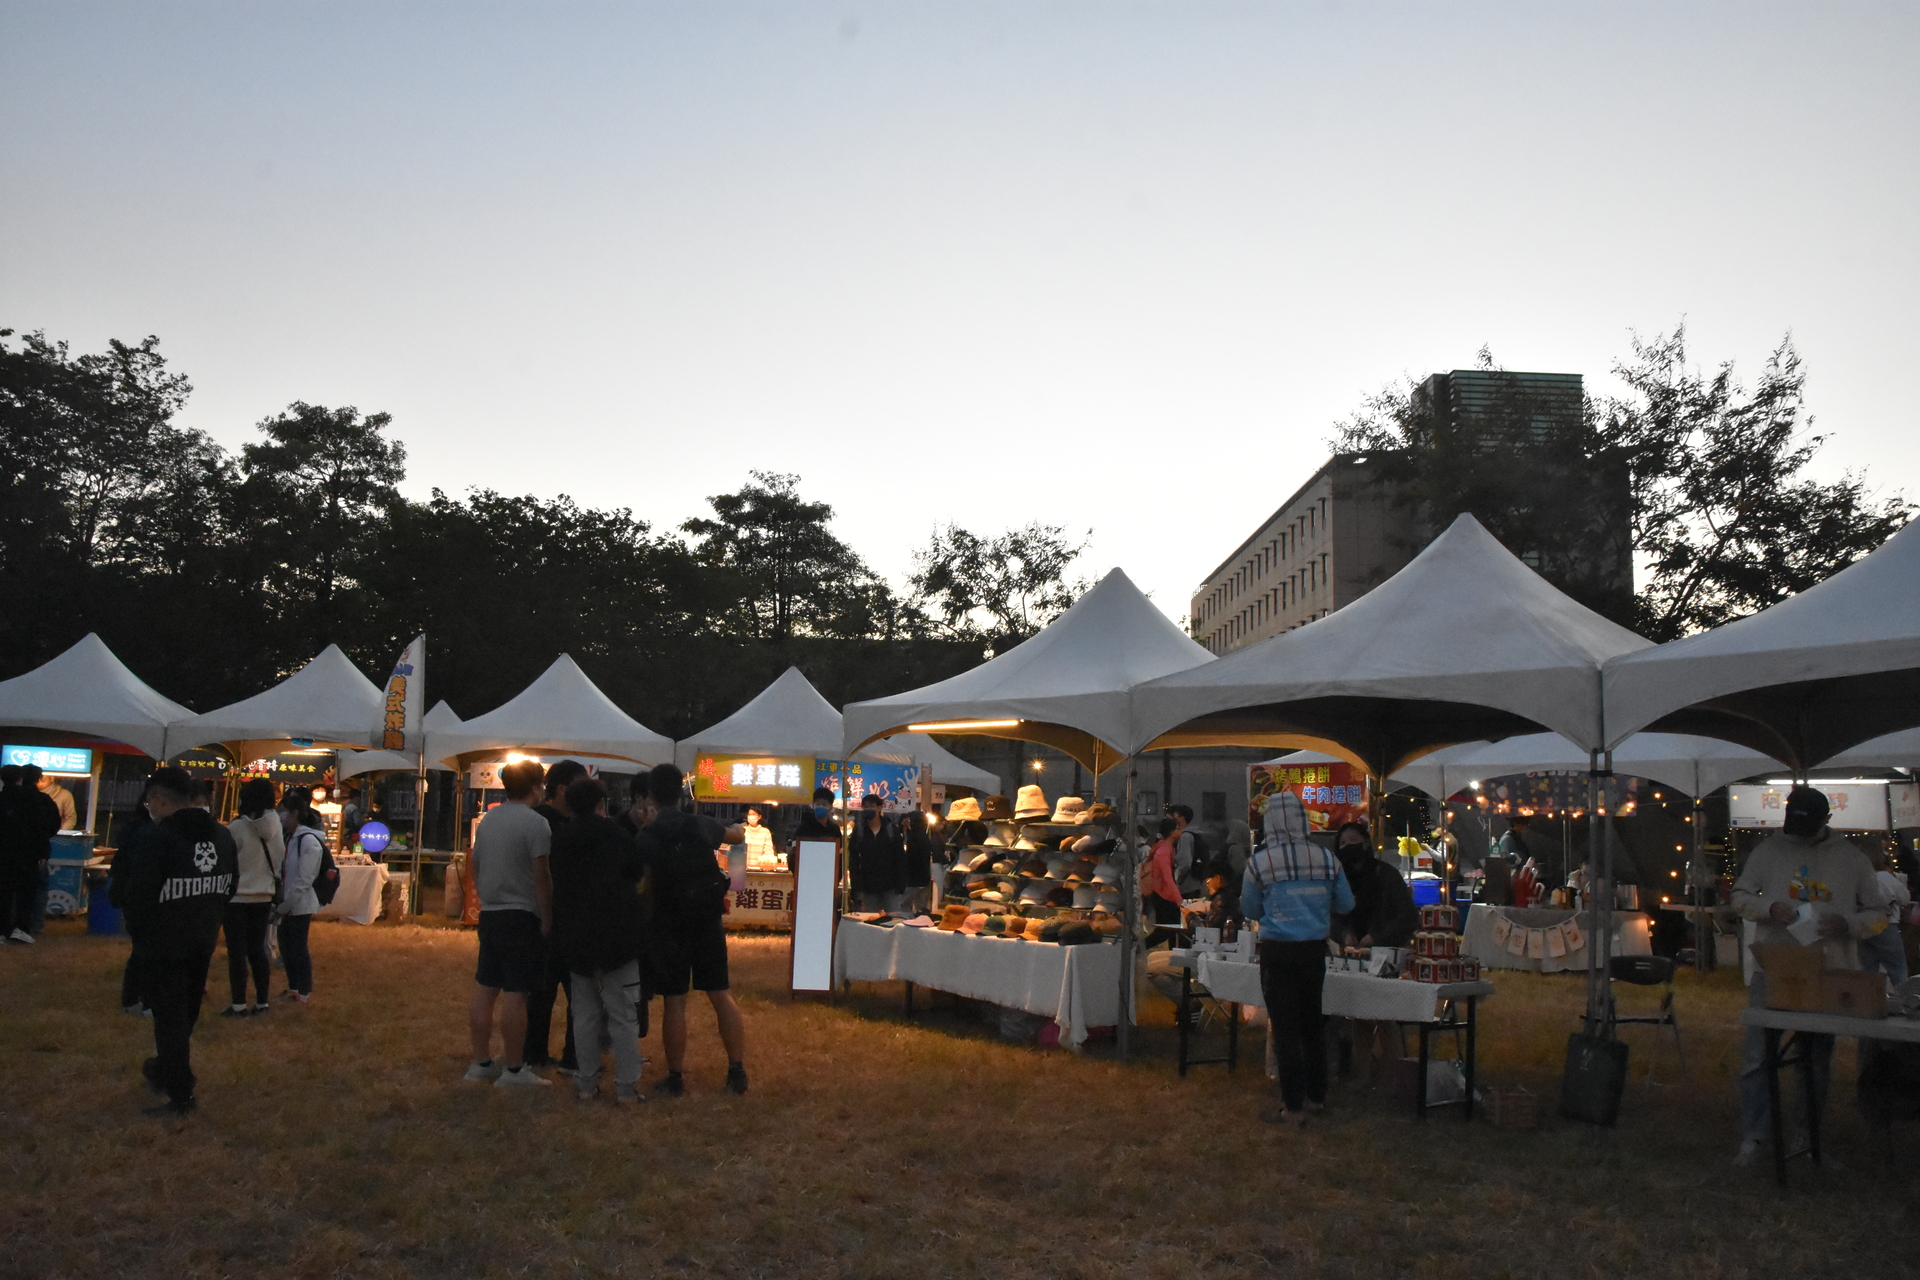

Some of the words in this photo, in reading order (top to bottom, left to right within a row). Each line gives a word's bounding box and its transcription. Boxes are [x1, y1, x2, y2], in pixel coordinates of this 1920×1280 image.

[731, 763, 800, 787] 雞蛋糕
[1274, 766, 1330, 784] 烤鴨捲餅
[1301, 785, 1362, 804] 牛肉捲餅
